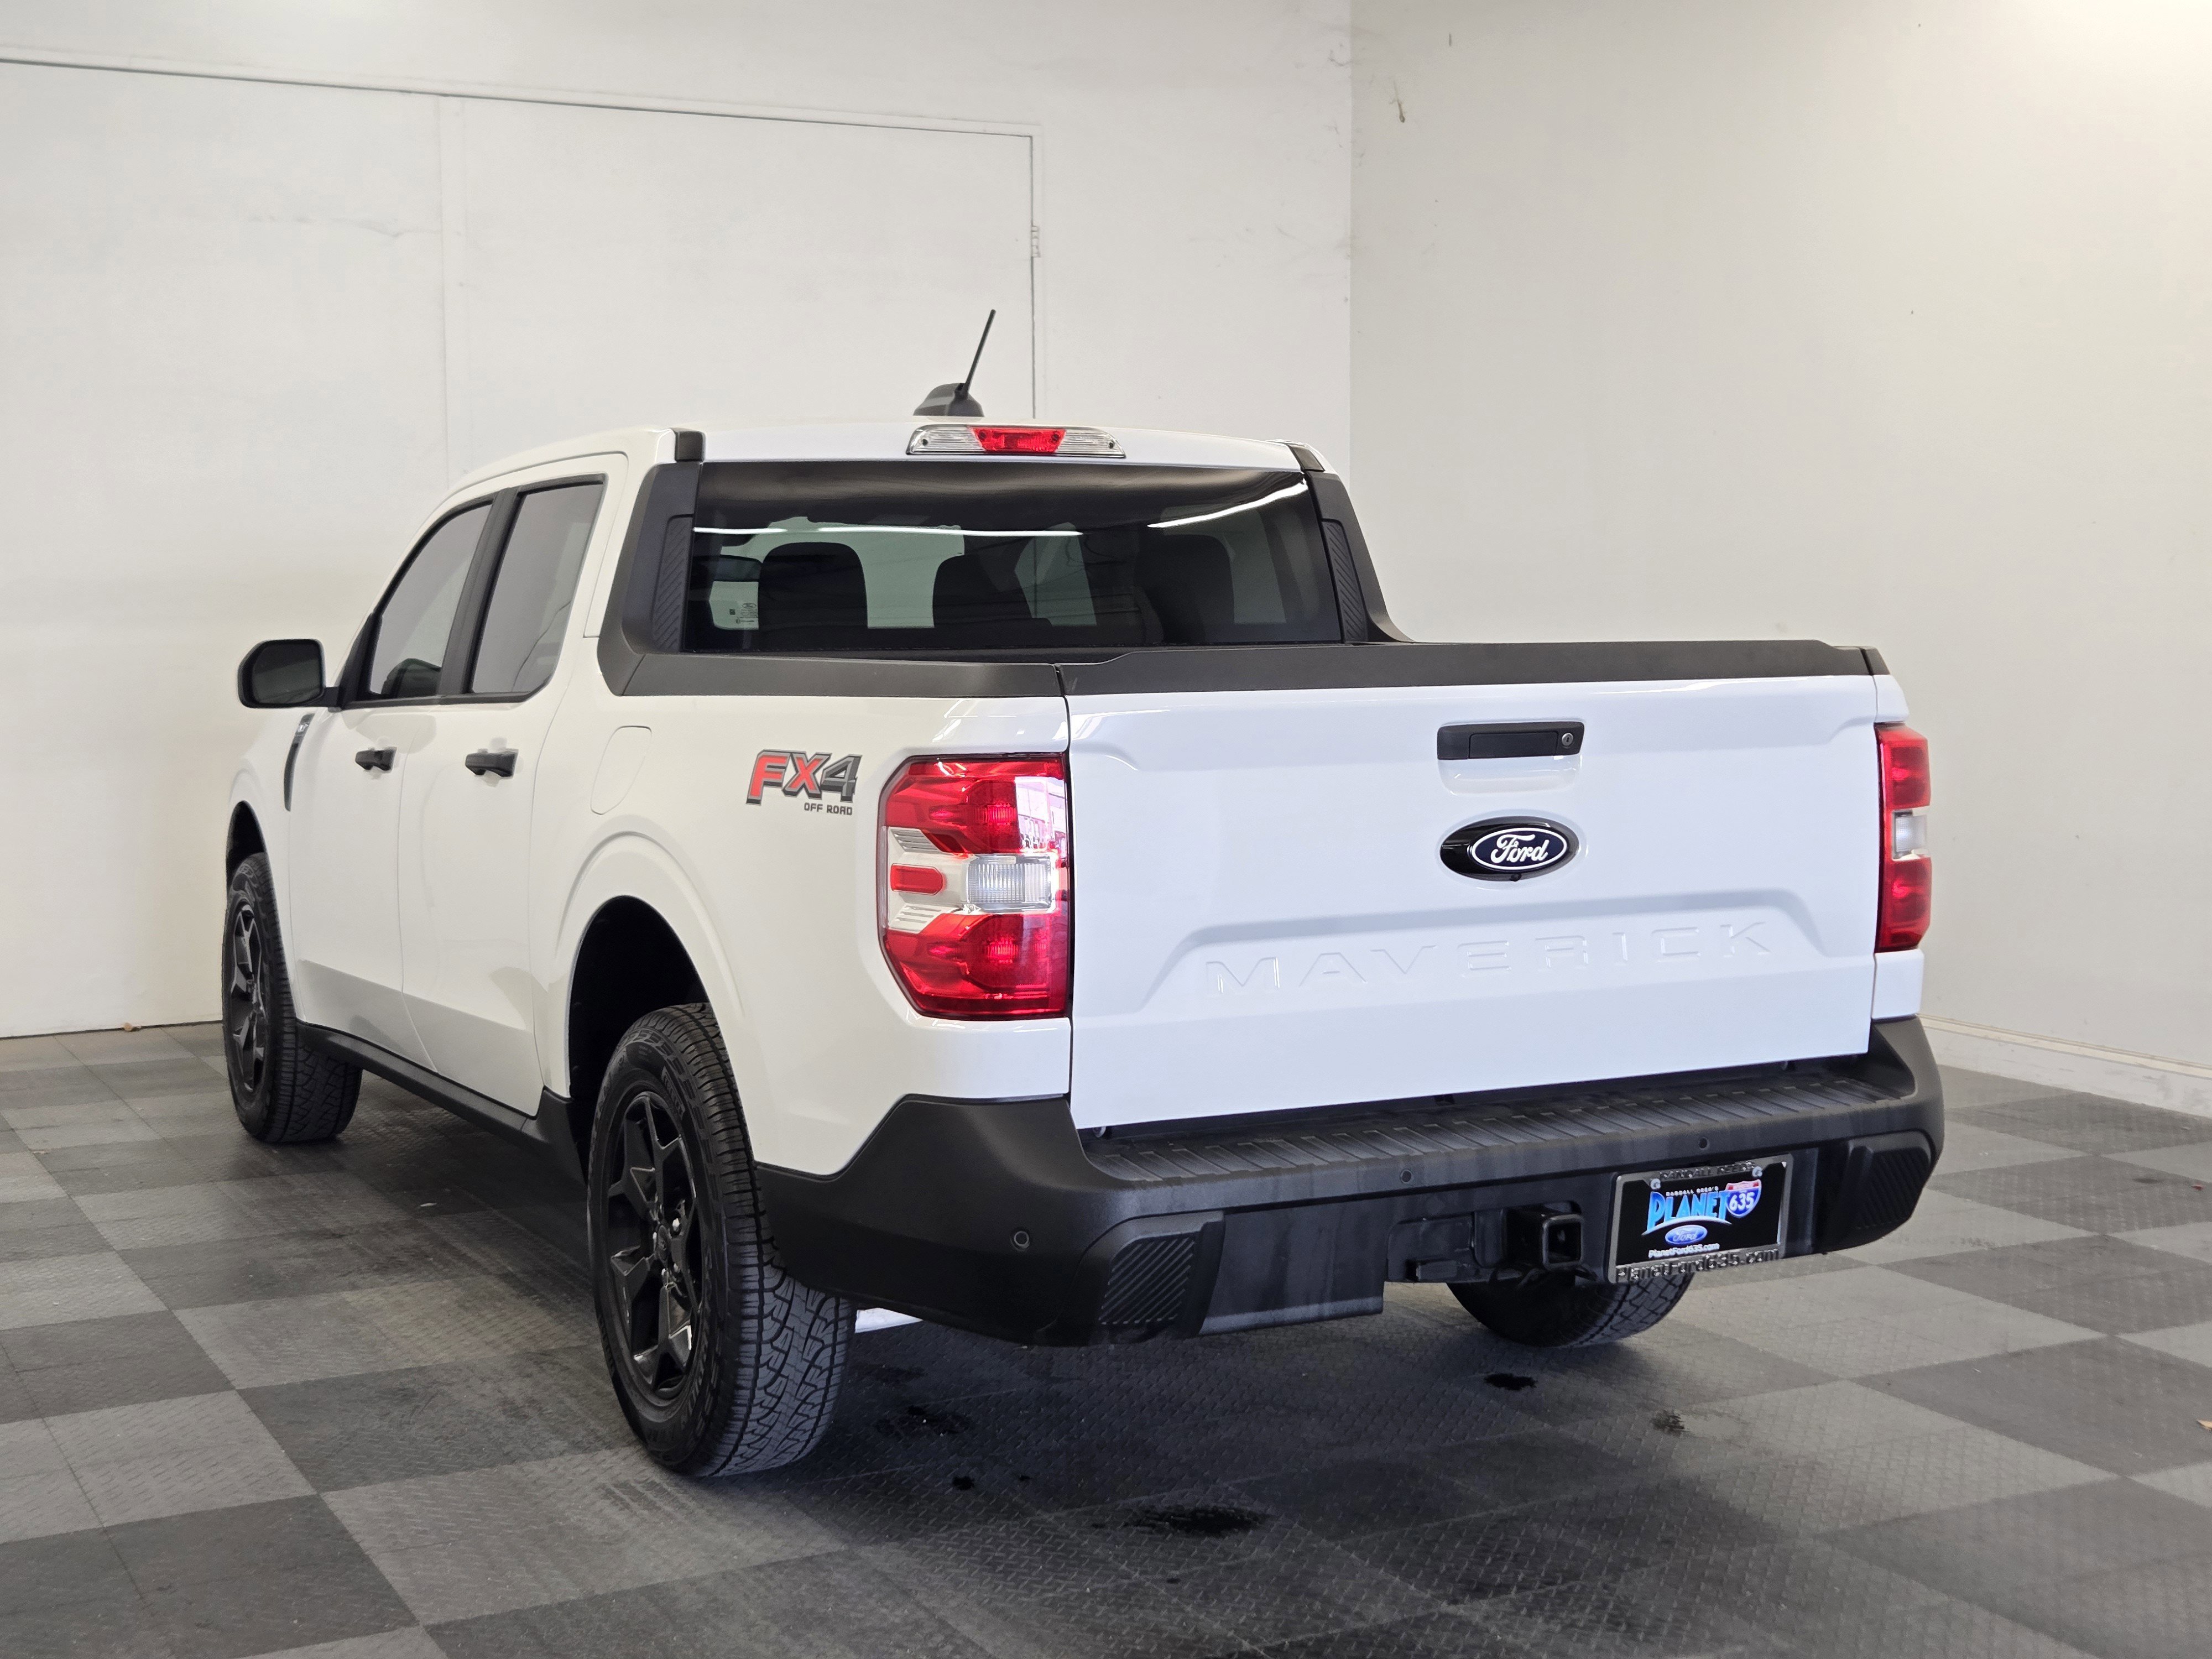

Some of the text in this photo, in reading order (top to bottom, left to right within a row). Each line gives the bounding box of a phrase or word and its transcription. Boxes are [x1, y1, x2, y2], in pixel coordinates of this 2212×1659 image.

[746, 749, 862, 805] FX4
[804, 802, 852, 815] OFF ROAD
[1491, 834, 1550, 863] Ford
[1206, 921, 1771, 997] MAVERICK
[1647, 1189, 1730, 1231] PLANET
[1729, 1192, 1755, 1212] 635
[1672, 1229, 1699, 1242] Ford
